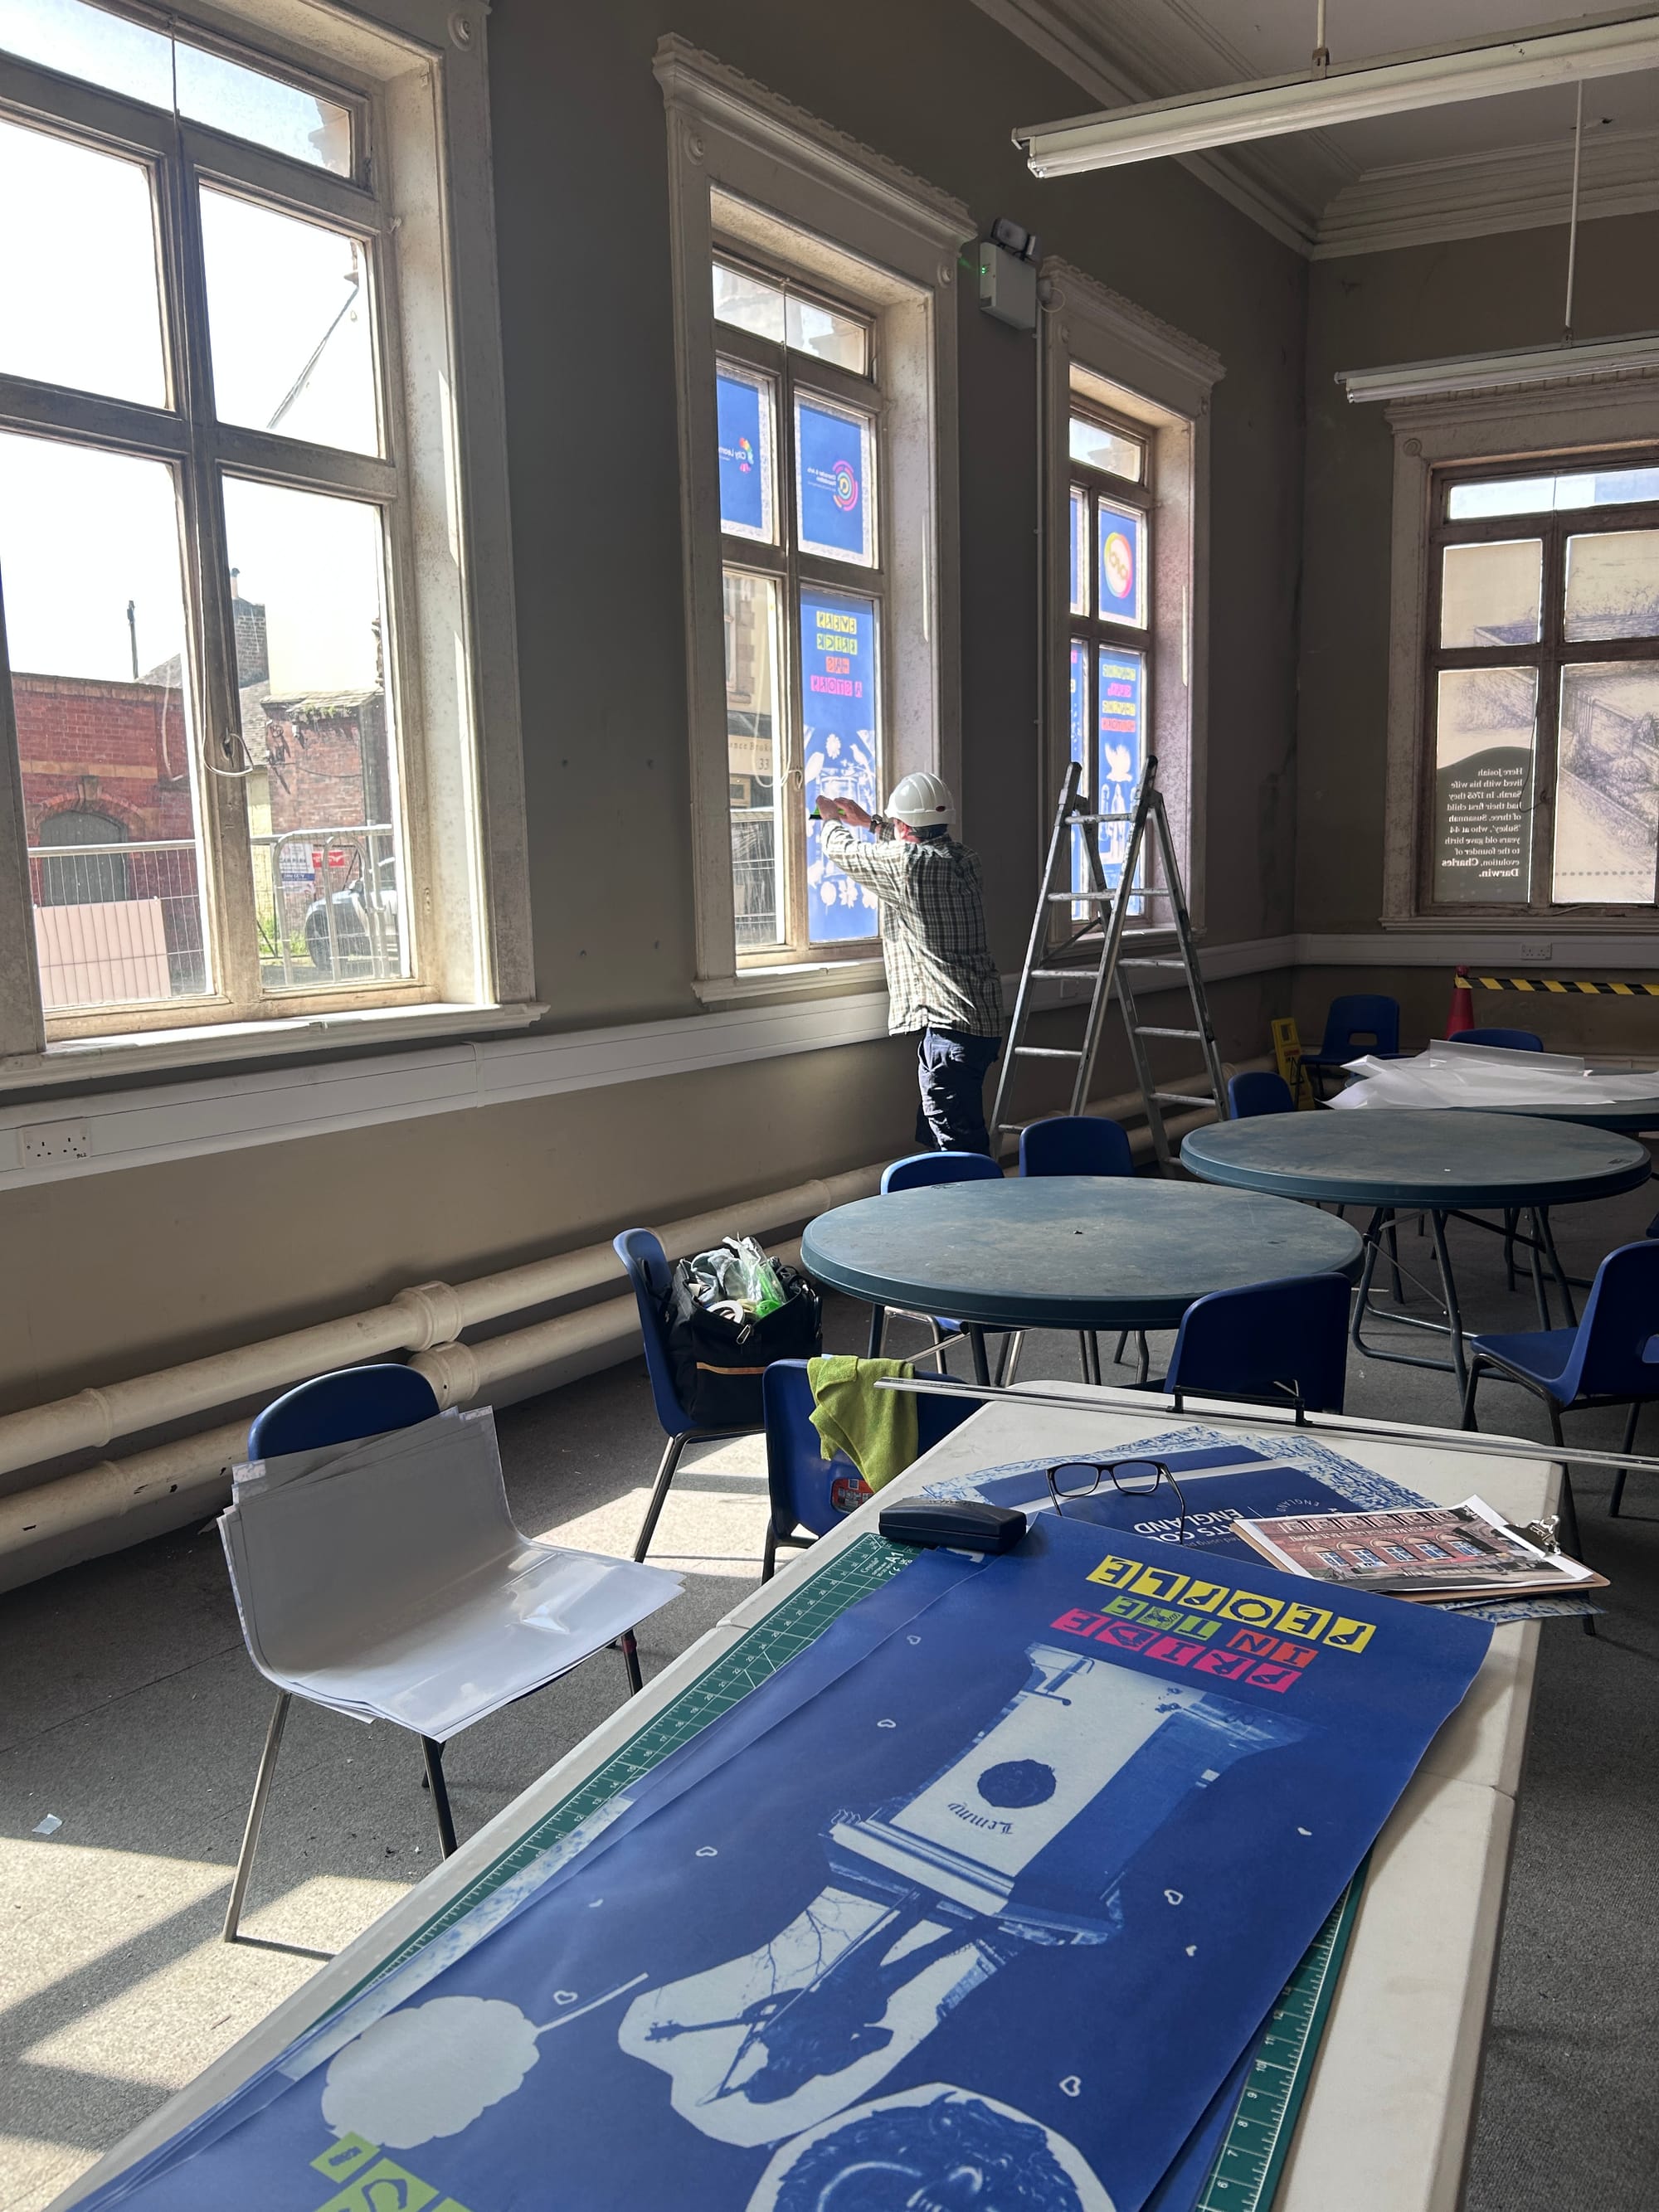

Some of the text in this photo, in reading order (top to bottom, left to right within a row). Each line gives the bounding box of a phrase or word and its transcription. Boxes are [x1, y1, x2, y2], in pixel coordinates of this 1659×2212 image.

[759, 758, 770, 771] 33
[1276, 1499, 1320, 1512] ENGLAND
[1134, 1508, 1244, 1534] ENGLAND
[885, 1551, 904, 1563] A1
[1097, 1558, 1369, 1646] PEOPLE
[1066, 1612, 1294, 1687] PRIDE
[1233, 1632, 1306, 1665] IN
[947, 1801, 1014, 1835] Lemmy
[1273, 2010, 1284, 2020] 12
[1265, 2036, 1275, 2046] 11
[1255, 2064, 1267, 2073] 10
[1217, 2180, 1228, 2189] 6
